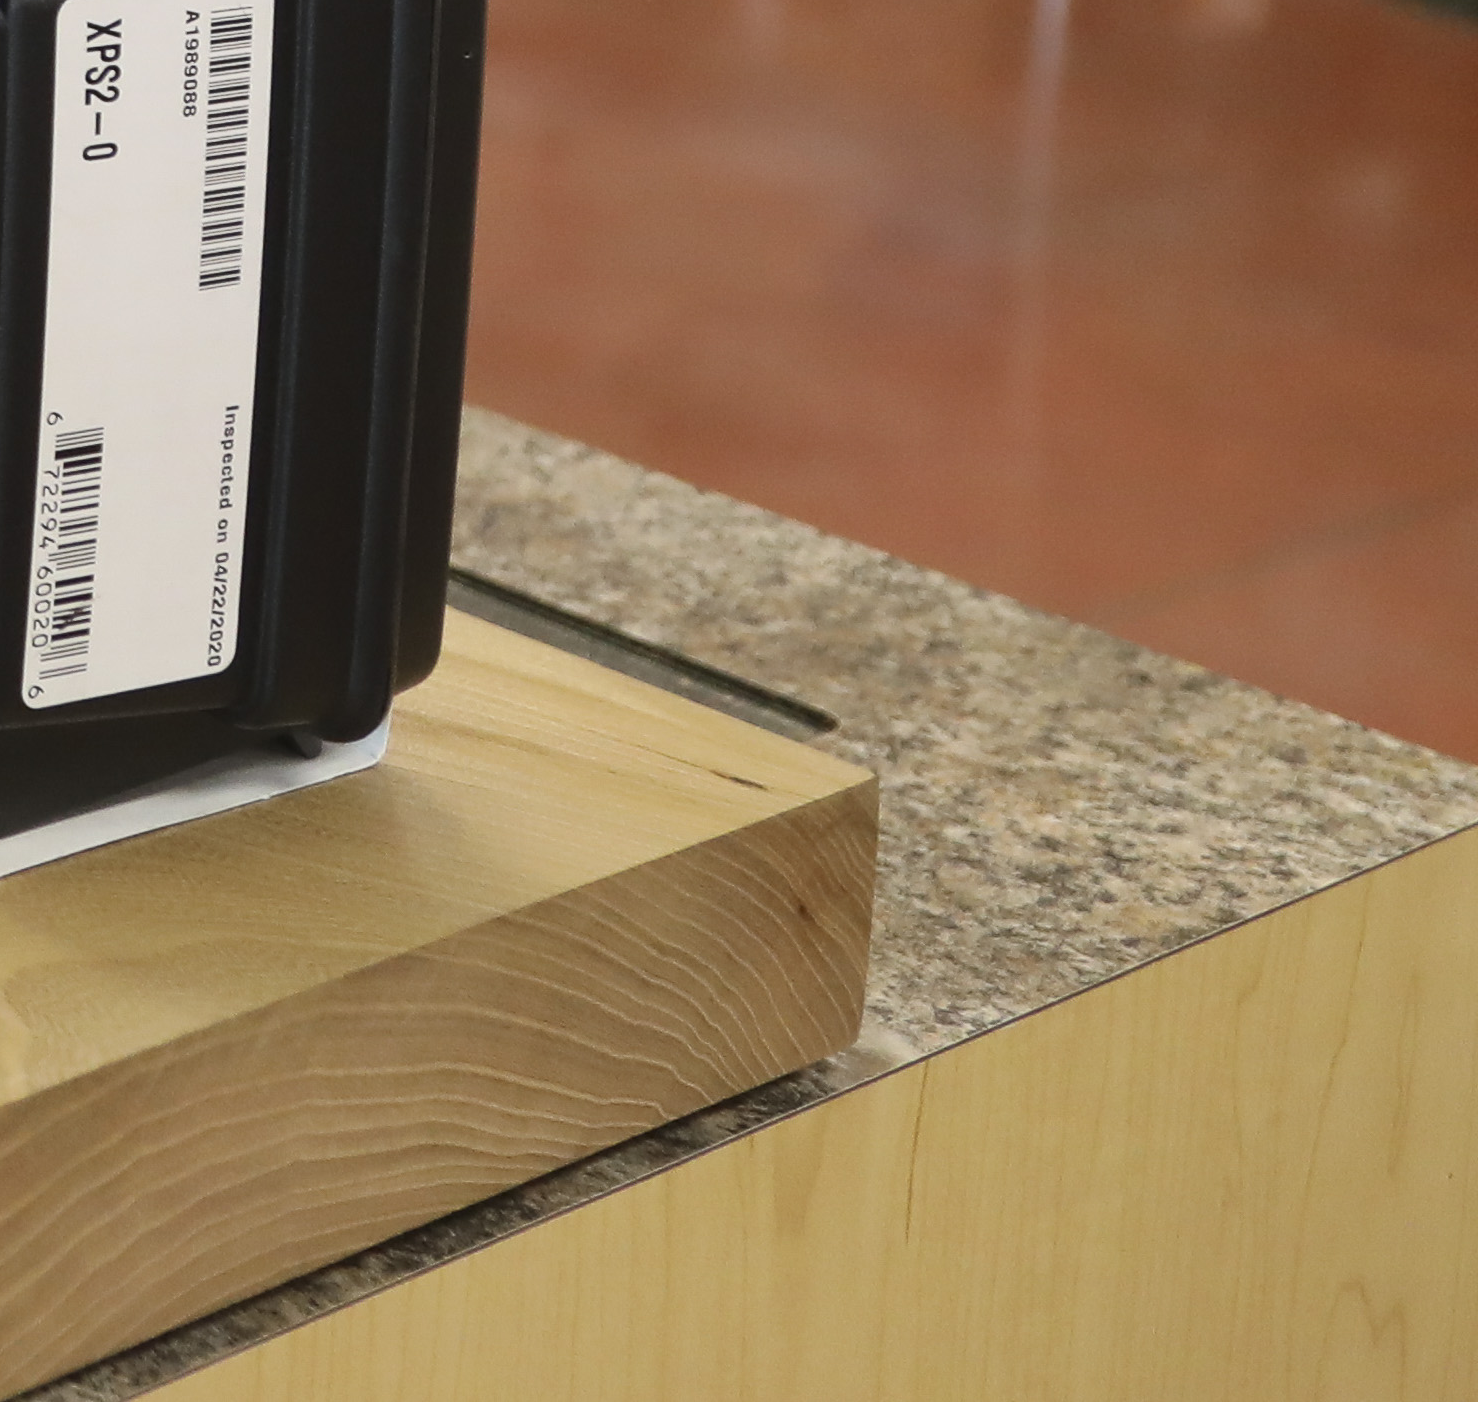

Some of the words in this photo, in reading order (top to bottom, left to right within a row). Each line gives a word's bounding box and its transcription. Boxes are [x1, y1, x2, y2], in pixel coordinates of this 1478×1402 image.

[183, 10, 200, 119] A1989088
[48, 412, 64, 426] 6
[218, 405, 238, 510] Inspected
[40, 469, 61, 550] 72294
[217, 517, 231, 545] on
[206, 551, 231, 669] 04/22/2020
[27, 684, 45, 701] 6
